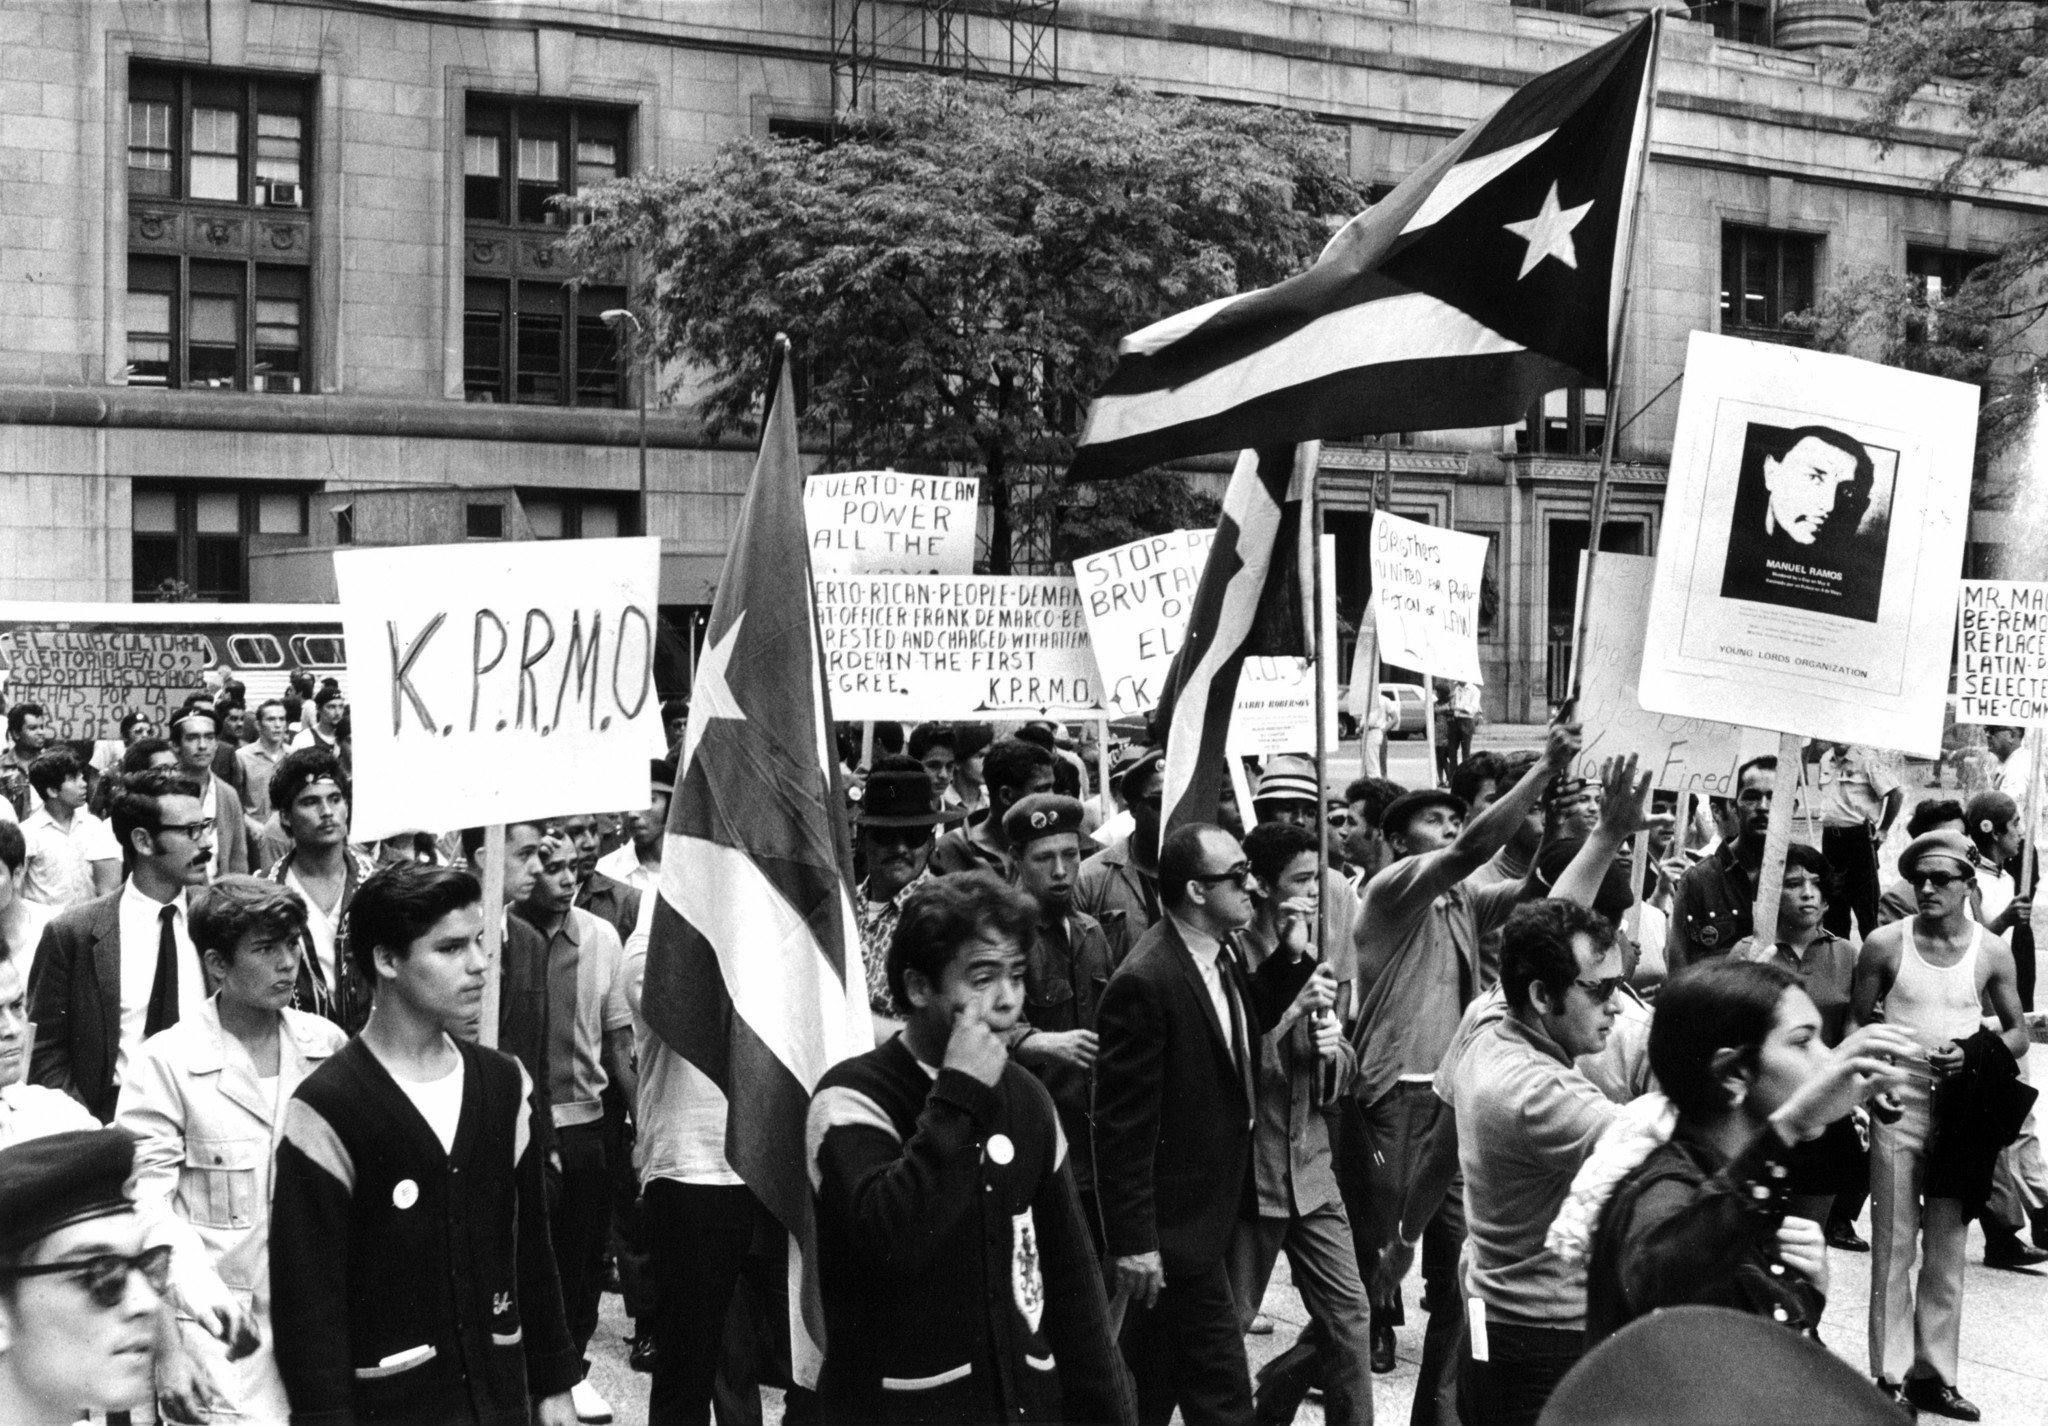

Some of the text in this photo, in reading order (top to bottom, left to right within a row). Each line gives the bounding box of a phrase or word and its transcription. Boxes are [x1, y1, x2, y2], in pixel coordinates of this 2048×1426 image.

[843, 500, 951, 532] POWER
[813, 528, 945, 556] ALL THE
[1765, 559, 1843, 581] MANUEL RAMOS
[1964, 586, 2048, 612] MR. MA
[839, 606, 908, 627] OFFICER
[914, 607, 969, 628] FRANK
[13, 632, 49, 650] EL
[53, 633, 106, 652] CLUB
[826, 650, 885, 671] RDER
[919, 651, 962, 671] THE
[972, 651, 1036, 671] FIRST
[1719, 645, 1868, 678] YOUNG LORDS ORGANIZATION
[14, 685, 167, 706] HECHAS POR LA
[1658, 740, 1738, 794] Fired
